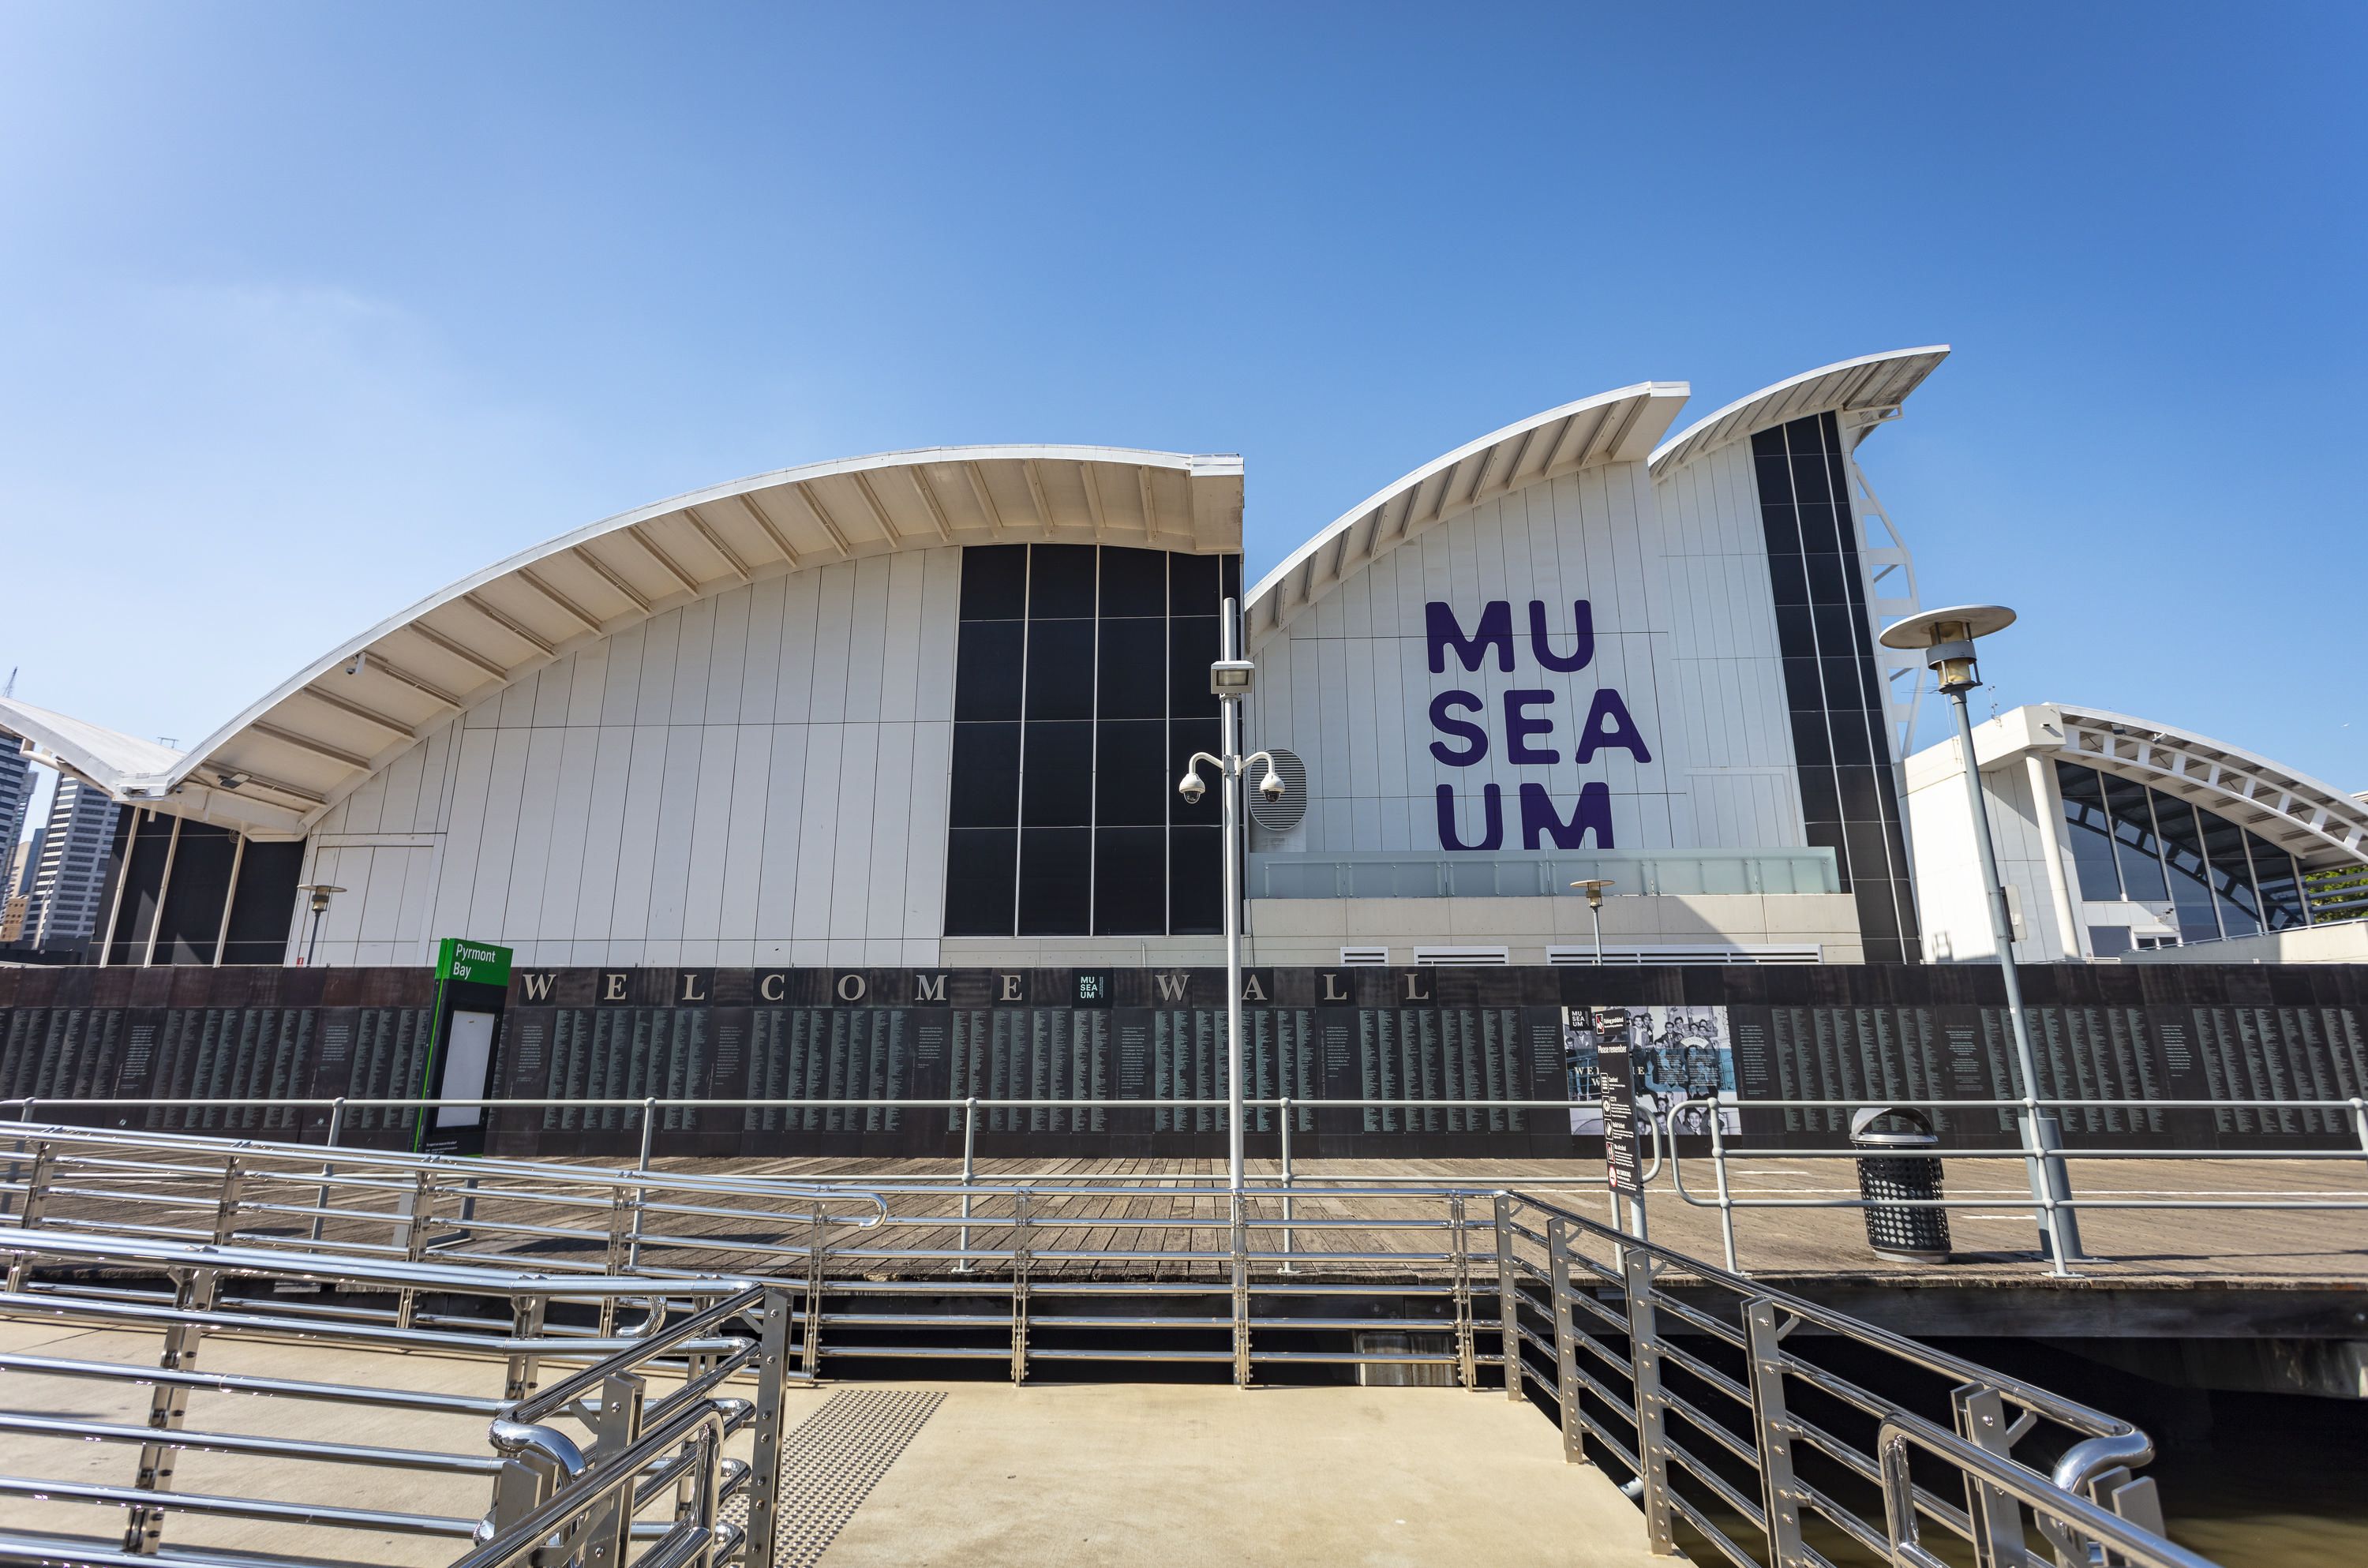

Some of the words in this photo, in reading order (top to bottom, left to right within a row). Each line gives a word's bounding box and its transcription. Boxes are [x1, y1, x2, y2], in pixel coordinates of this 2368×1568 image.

[1426, 600, 1594, 673] MU
[1429, 689, 1652, 767] SEA
[1436, 782, 1614, 851] UM
[453, 962, 471, 979] Bay
[456, 944, 496, 963] Pyrmont
[1598, 1045, 1609, 1053] Please
[1609, 1044, 1627, 1053] remember
